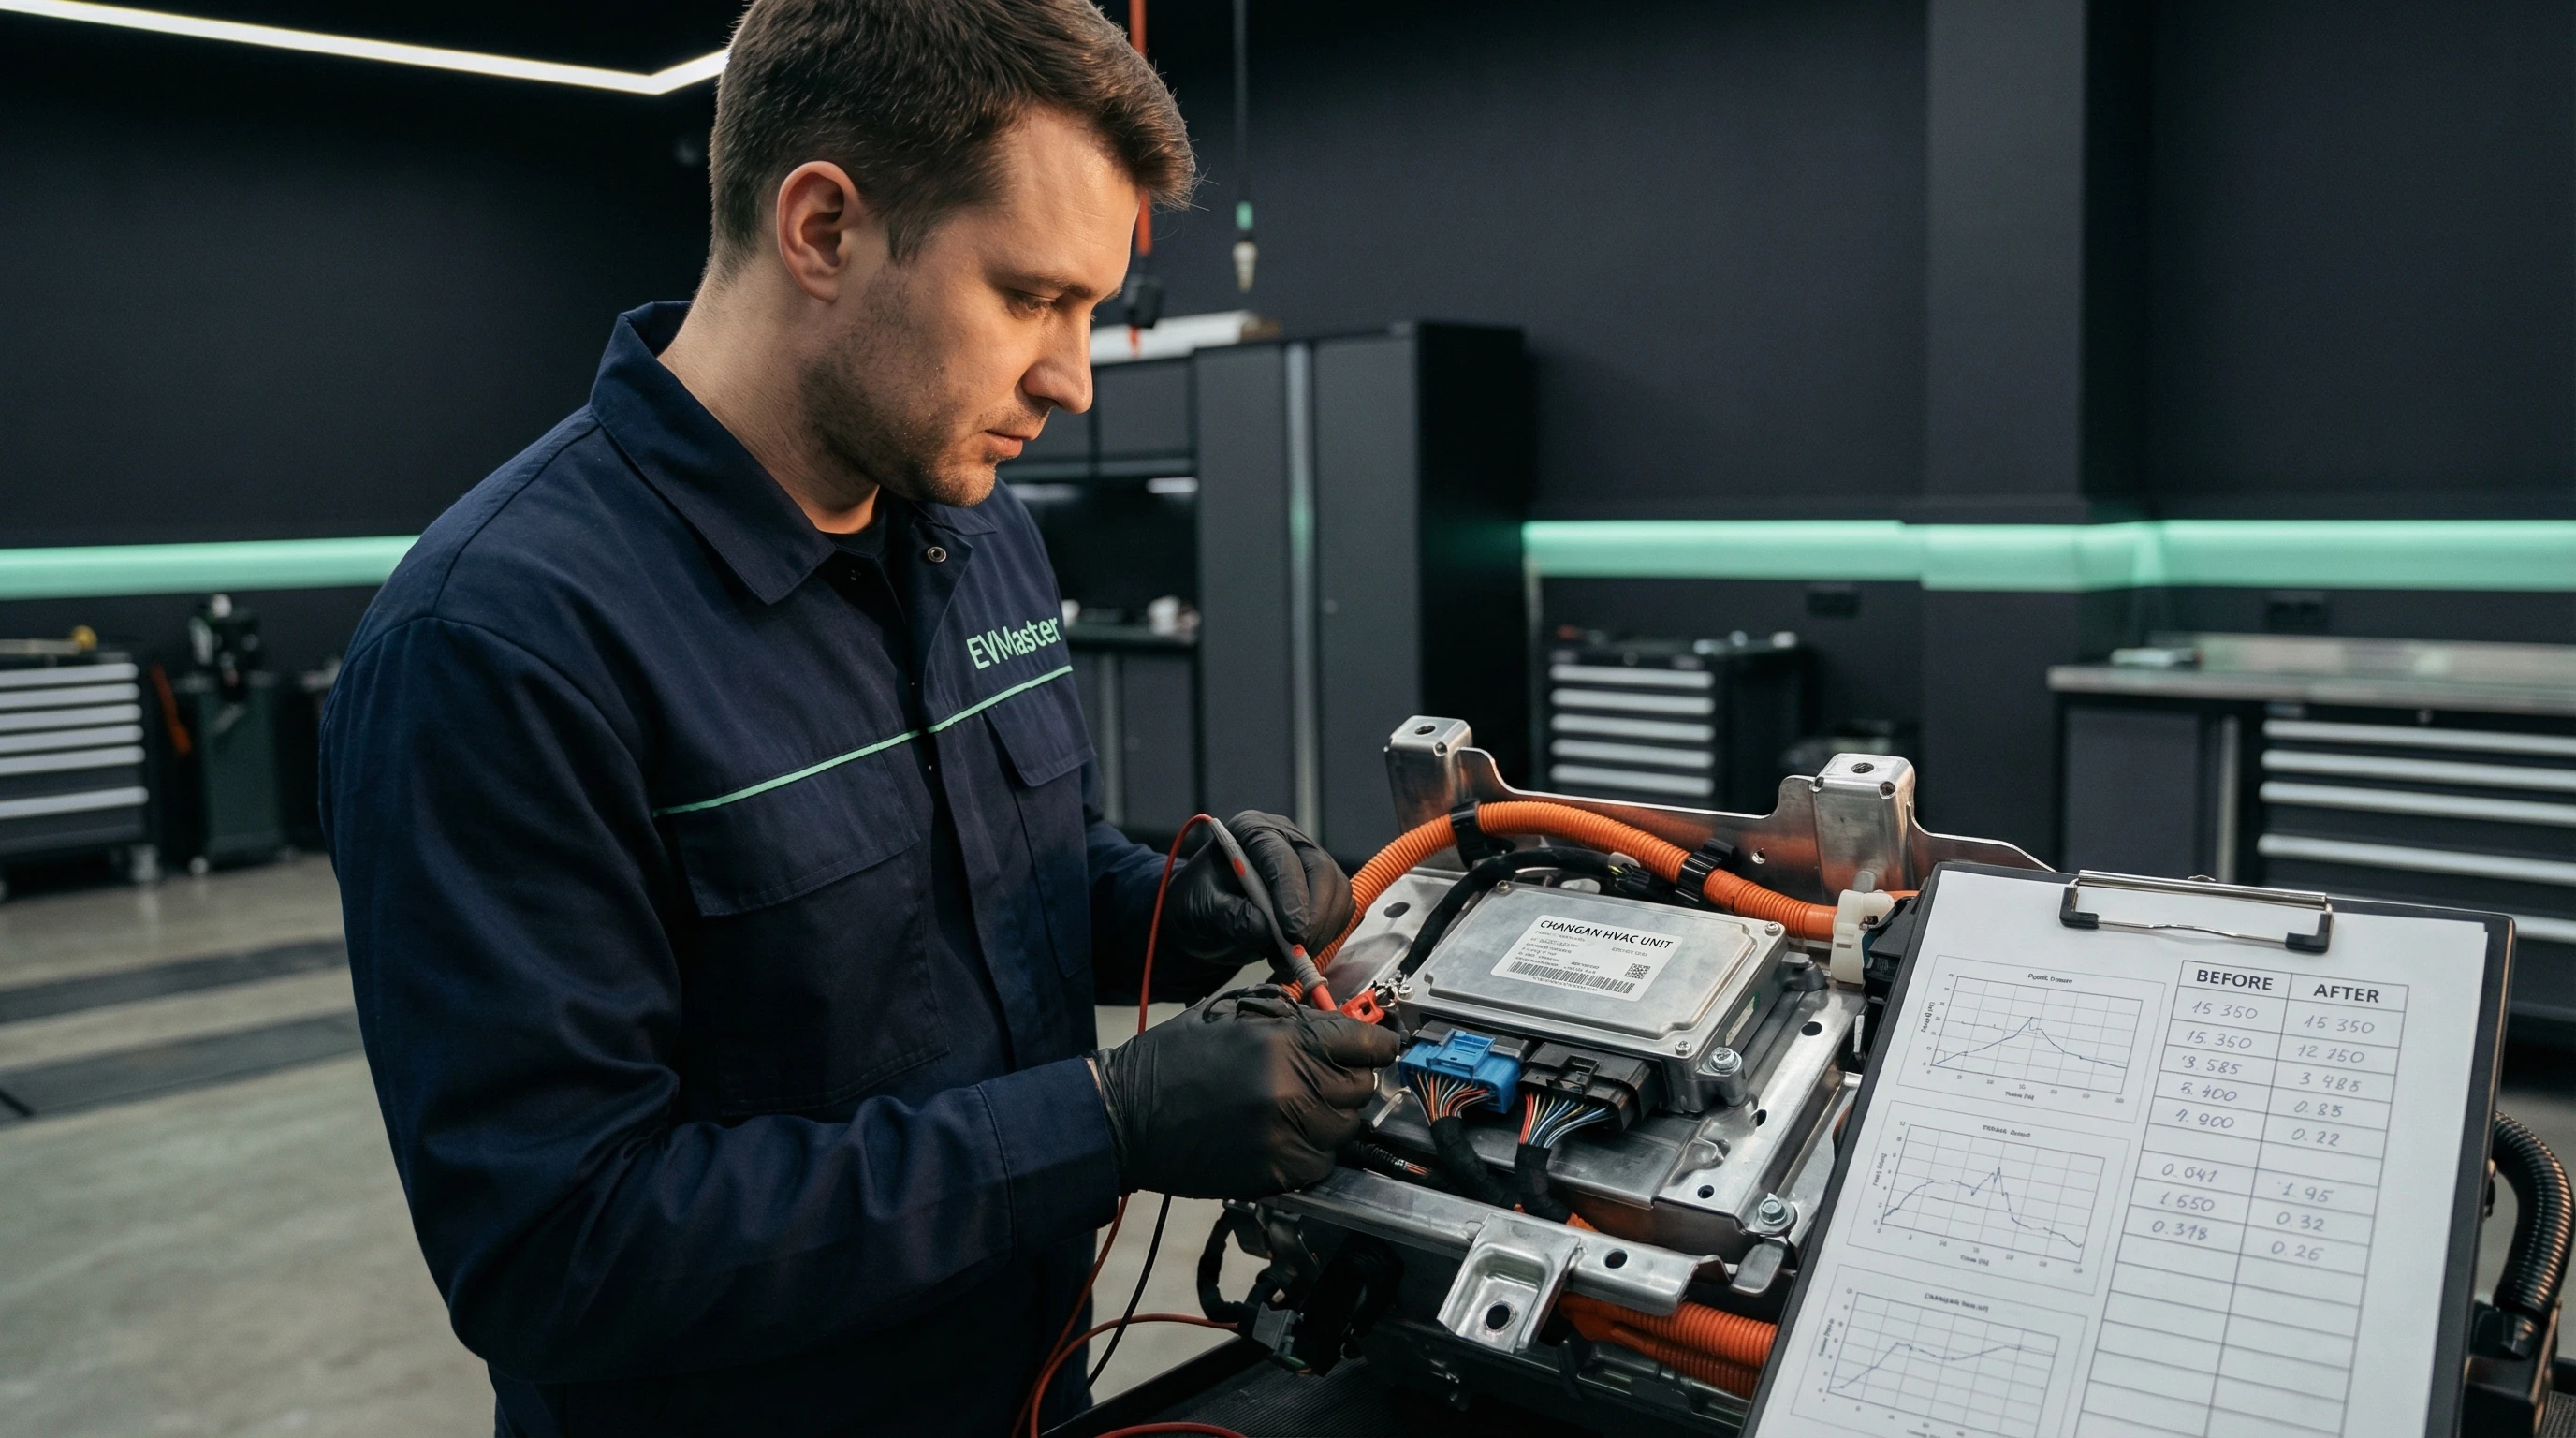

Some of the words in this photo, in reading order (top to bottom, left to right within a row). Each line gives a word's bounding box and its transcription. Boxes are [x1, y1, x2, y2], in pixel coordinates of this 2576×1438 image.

[966, 617, 1061, 669] EVMaster
[1540, 919, 1603, 938] CHANGAN
[1603, 930, 1639, 945] HVAC
[1640, 937, 1674, 949] UNIT
[2196, 969, 2274, 990] BEFORE
[2313, 984, 2379, 1004] AFTER
[2192, 1001, 2213, 1015] 15
[2304, 1015, 2329, 1029] 15
[2336, 1019, 2375, 1034] 350
[2215, 1033, 2252, 1049] 350
